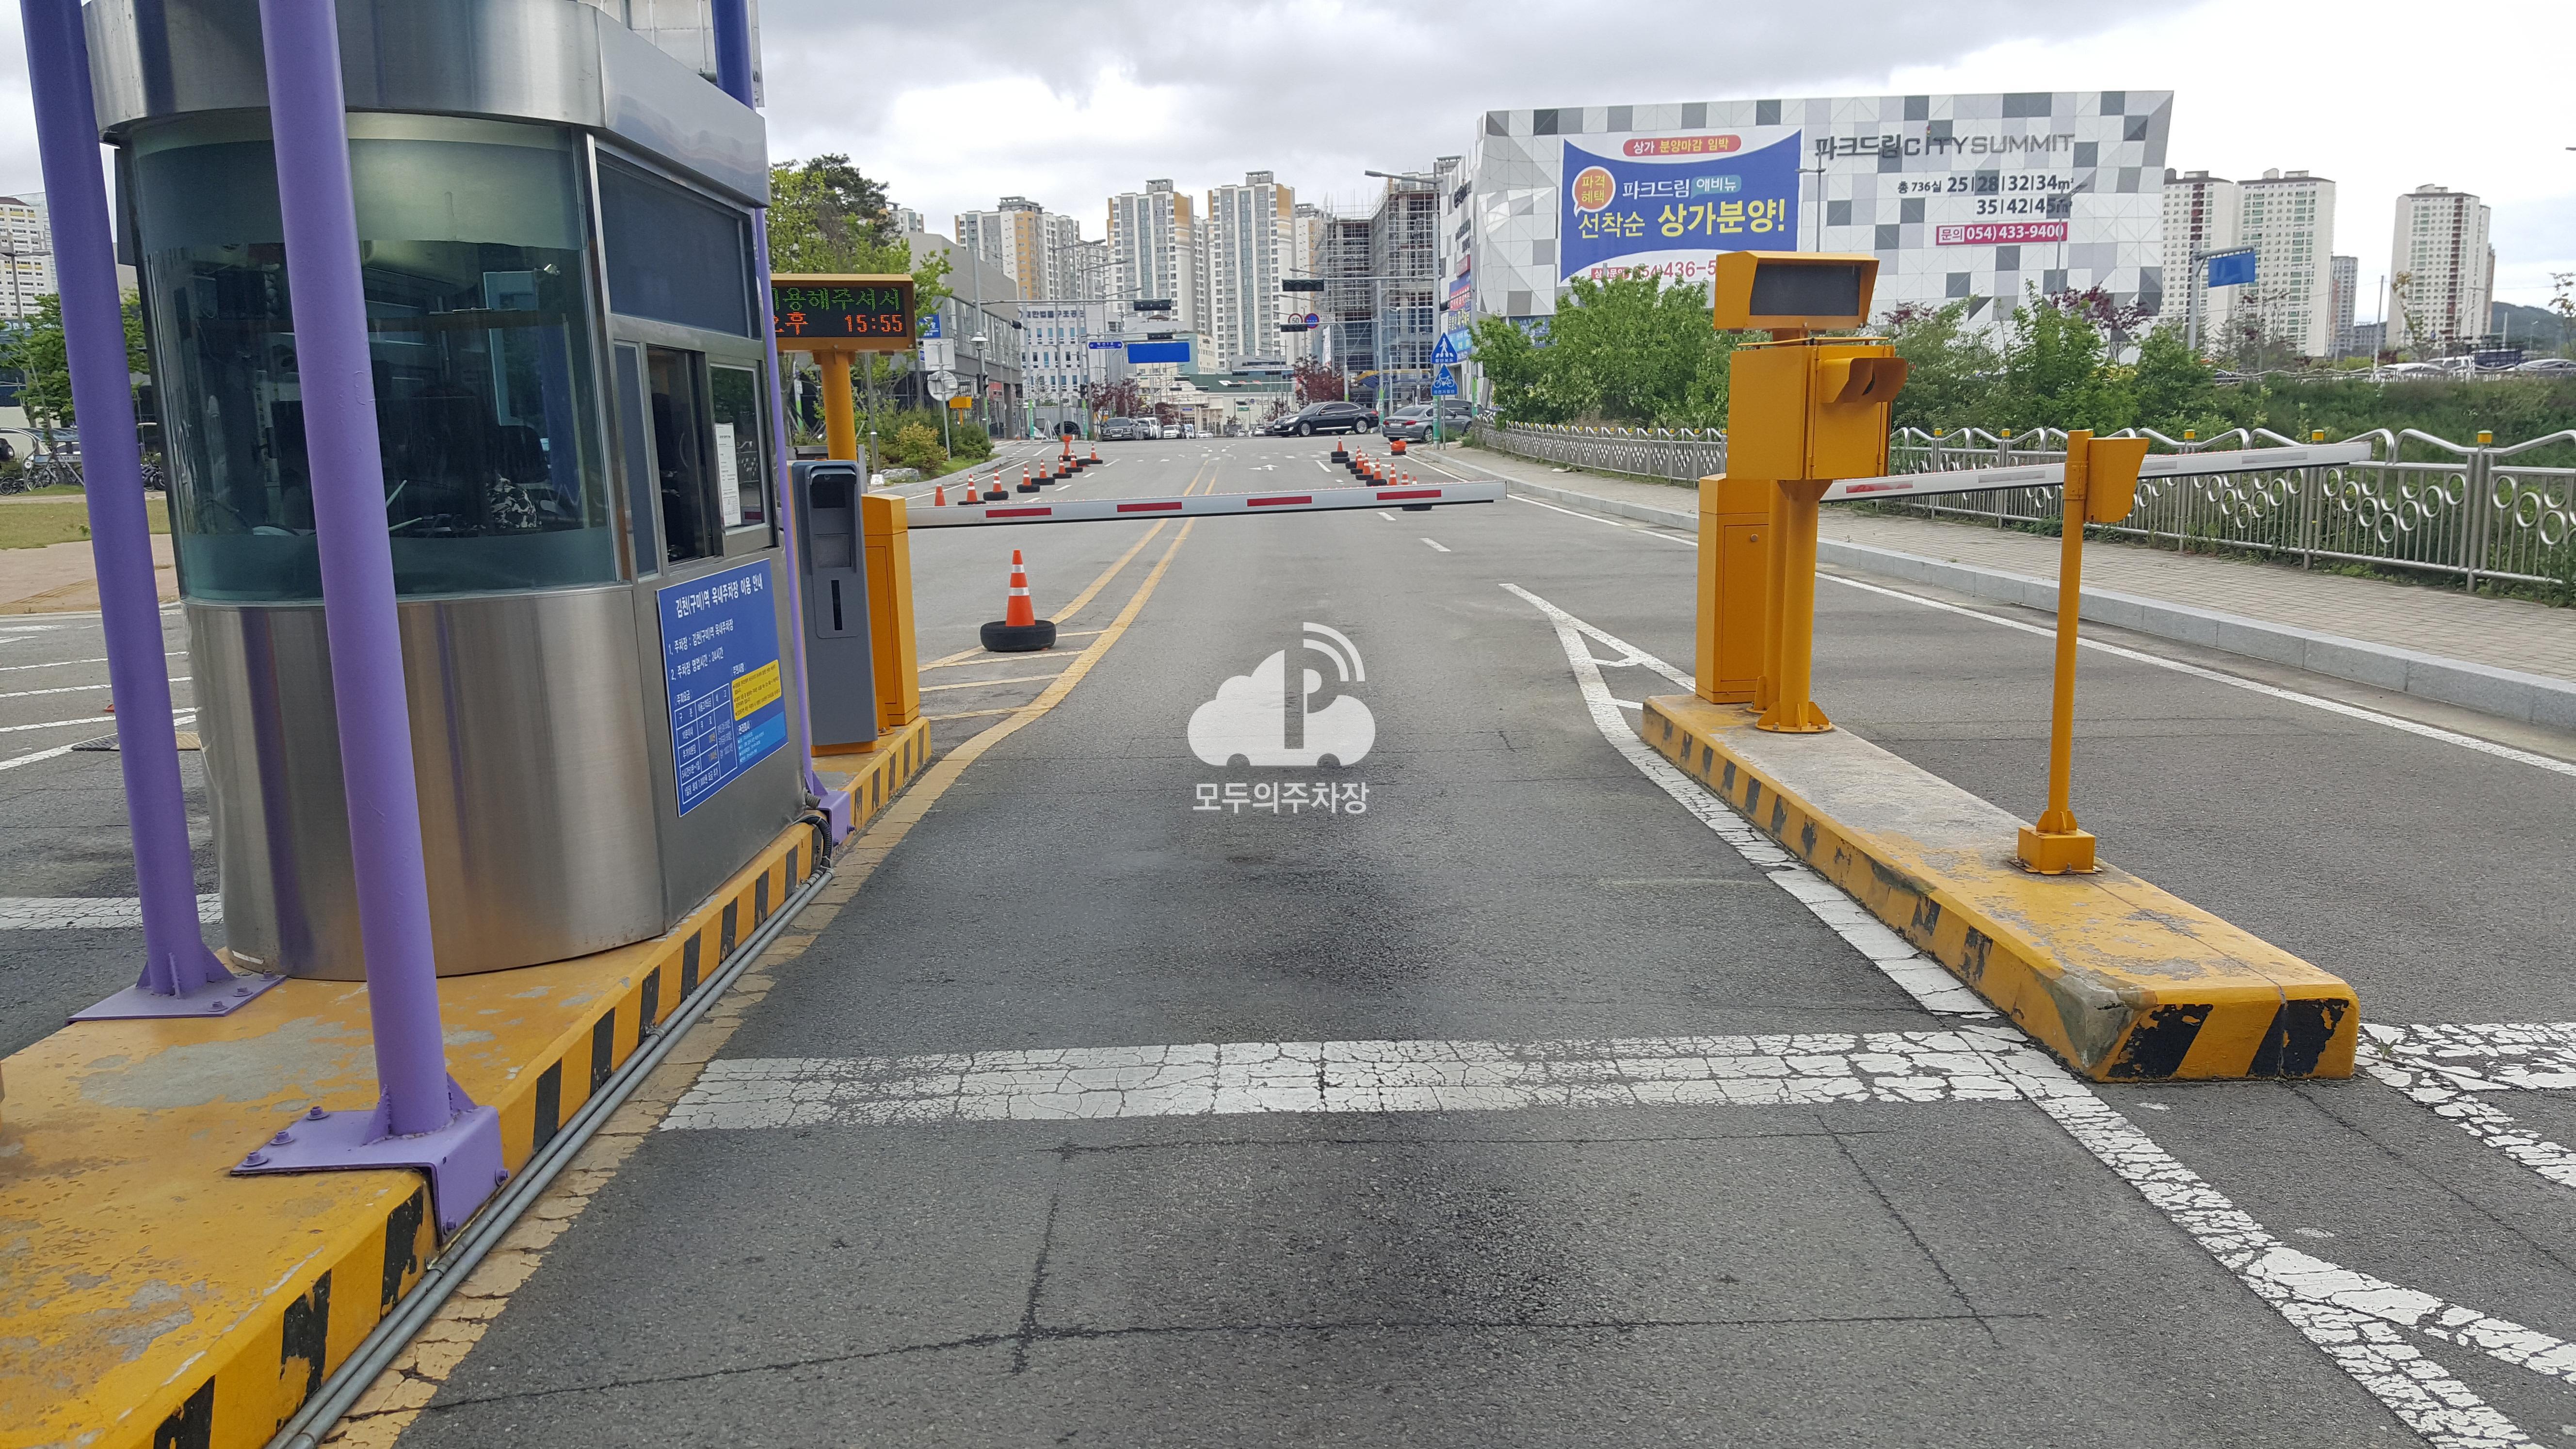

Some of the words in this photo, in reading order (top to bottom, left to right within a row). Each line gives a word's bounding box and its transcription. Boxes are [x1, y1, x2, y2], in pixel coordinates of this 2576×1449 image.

[1633, 141, 1655, 154] 상가
[1659, 139, 1703, 153] 분양마감
[1707, 138, 1729, 151] 임박
[1815, 133, 1901, 160] 파크드림
[1581, 174, 1606, 189] 파격
[1622, 178, 1690, 200] 파크드림
[1696, 177, 1737, 192] 애비뉴
[1898, 181, 1908, 193] 총
[1912, 180, 1942, 193] 736실
[1581, 190, 1605, 204] 혜택
[1578, 211, 1645, 239] 선착순
[1657, 198, 1785, 237] 상가분양!
[1941, 228, 1963, 241] 문의
[845, 314, 903, 333] 15:55
[676, 589, 710, 618] 김천(구미)역
[712, 580, 739, 605] 옥내주차장
[741, 577, 751, 596] 이용
[753, 573, 763, 592] 안내
[668, 644, 674, 655] 1.
[675, 636, 688, 653] 주차장
[715, 618, 734, 637] 옥내주차장
[671, 669, 676, 680] 2.
[677, 661, 691, 678] 주차장
[692, 654, 708, 672] 영업시간
[711, 646, 724, 662] 24시간
